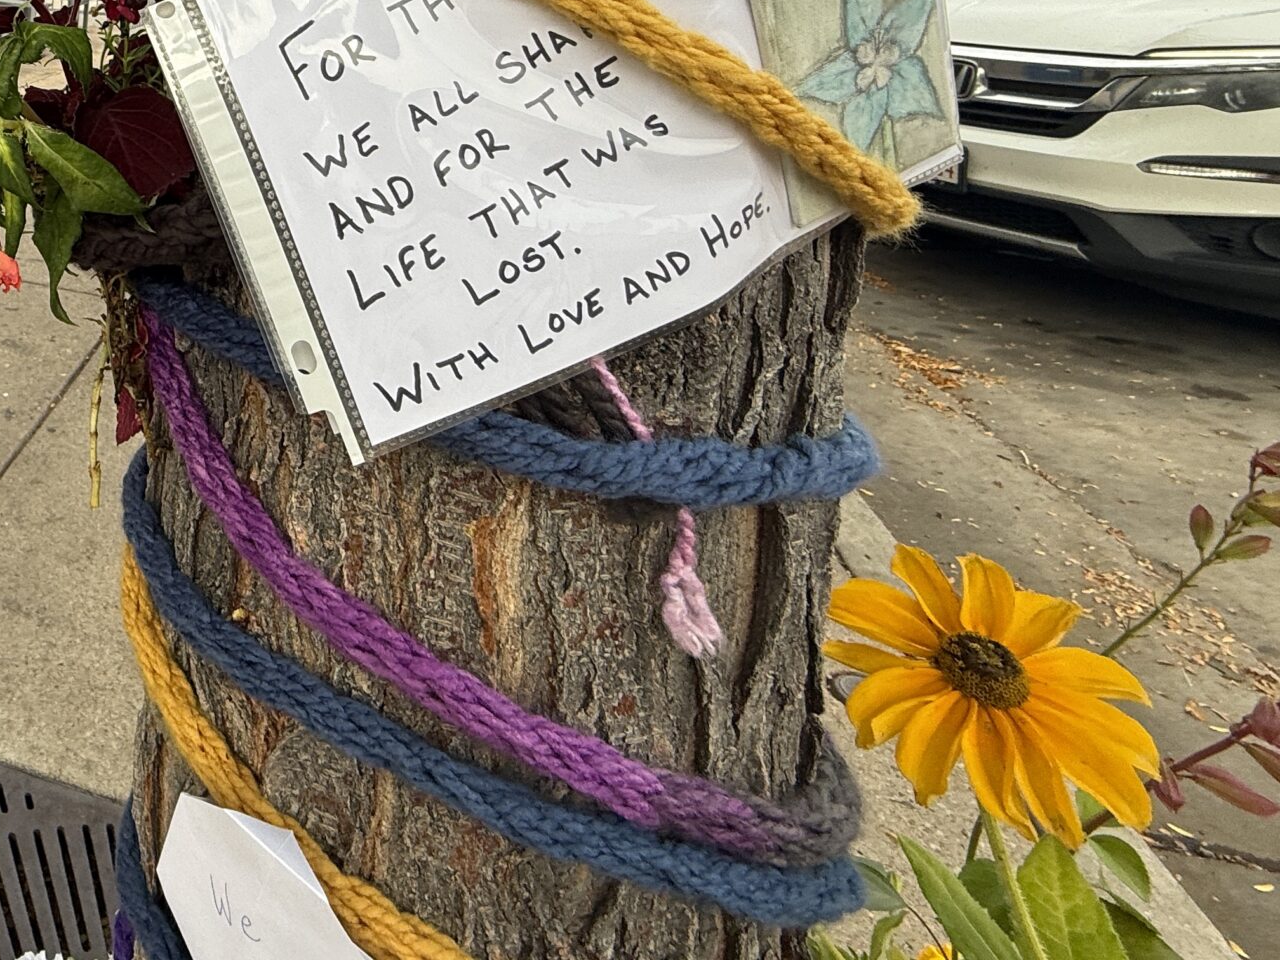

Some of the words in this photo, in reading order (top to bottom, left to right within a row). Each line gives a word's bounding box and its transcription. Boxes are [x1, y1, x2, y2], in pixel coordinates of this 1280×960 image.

[279, 20, 376, 101] FOR
[303, 122, 380, 178] WE
[408, 82, 480, 133] ALL
[496, 22, 594, 84] SHA
[329, 176, 414, 240] AND
[434, 131, 510, 187] FOR
[524, 56, 620, 120] THE
[347, 234, 447, 310] LIFE
[469, 159, 573, 239] THAT
[583, 114, 669, 168] WAS
[373, 342, 499, 412] WITH
[517, 287, 604, 354] LOVE
[624, 252, 691, 306] AND
[461, 233, 582, 306] LOST.
[210, 873, 261, 942] We
